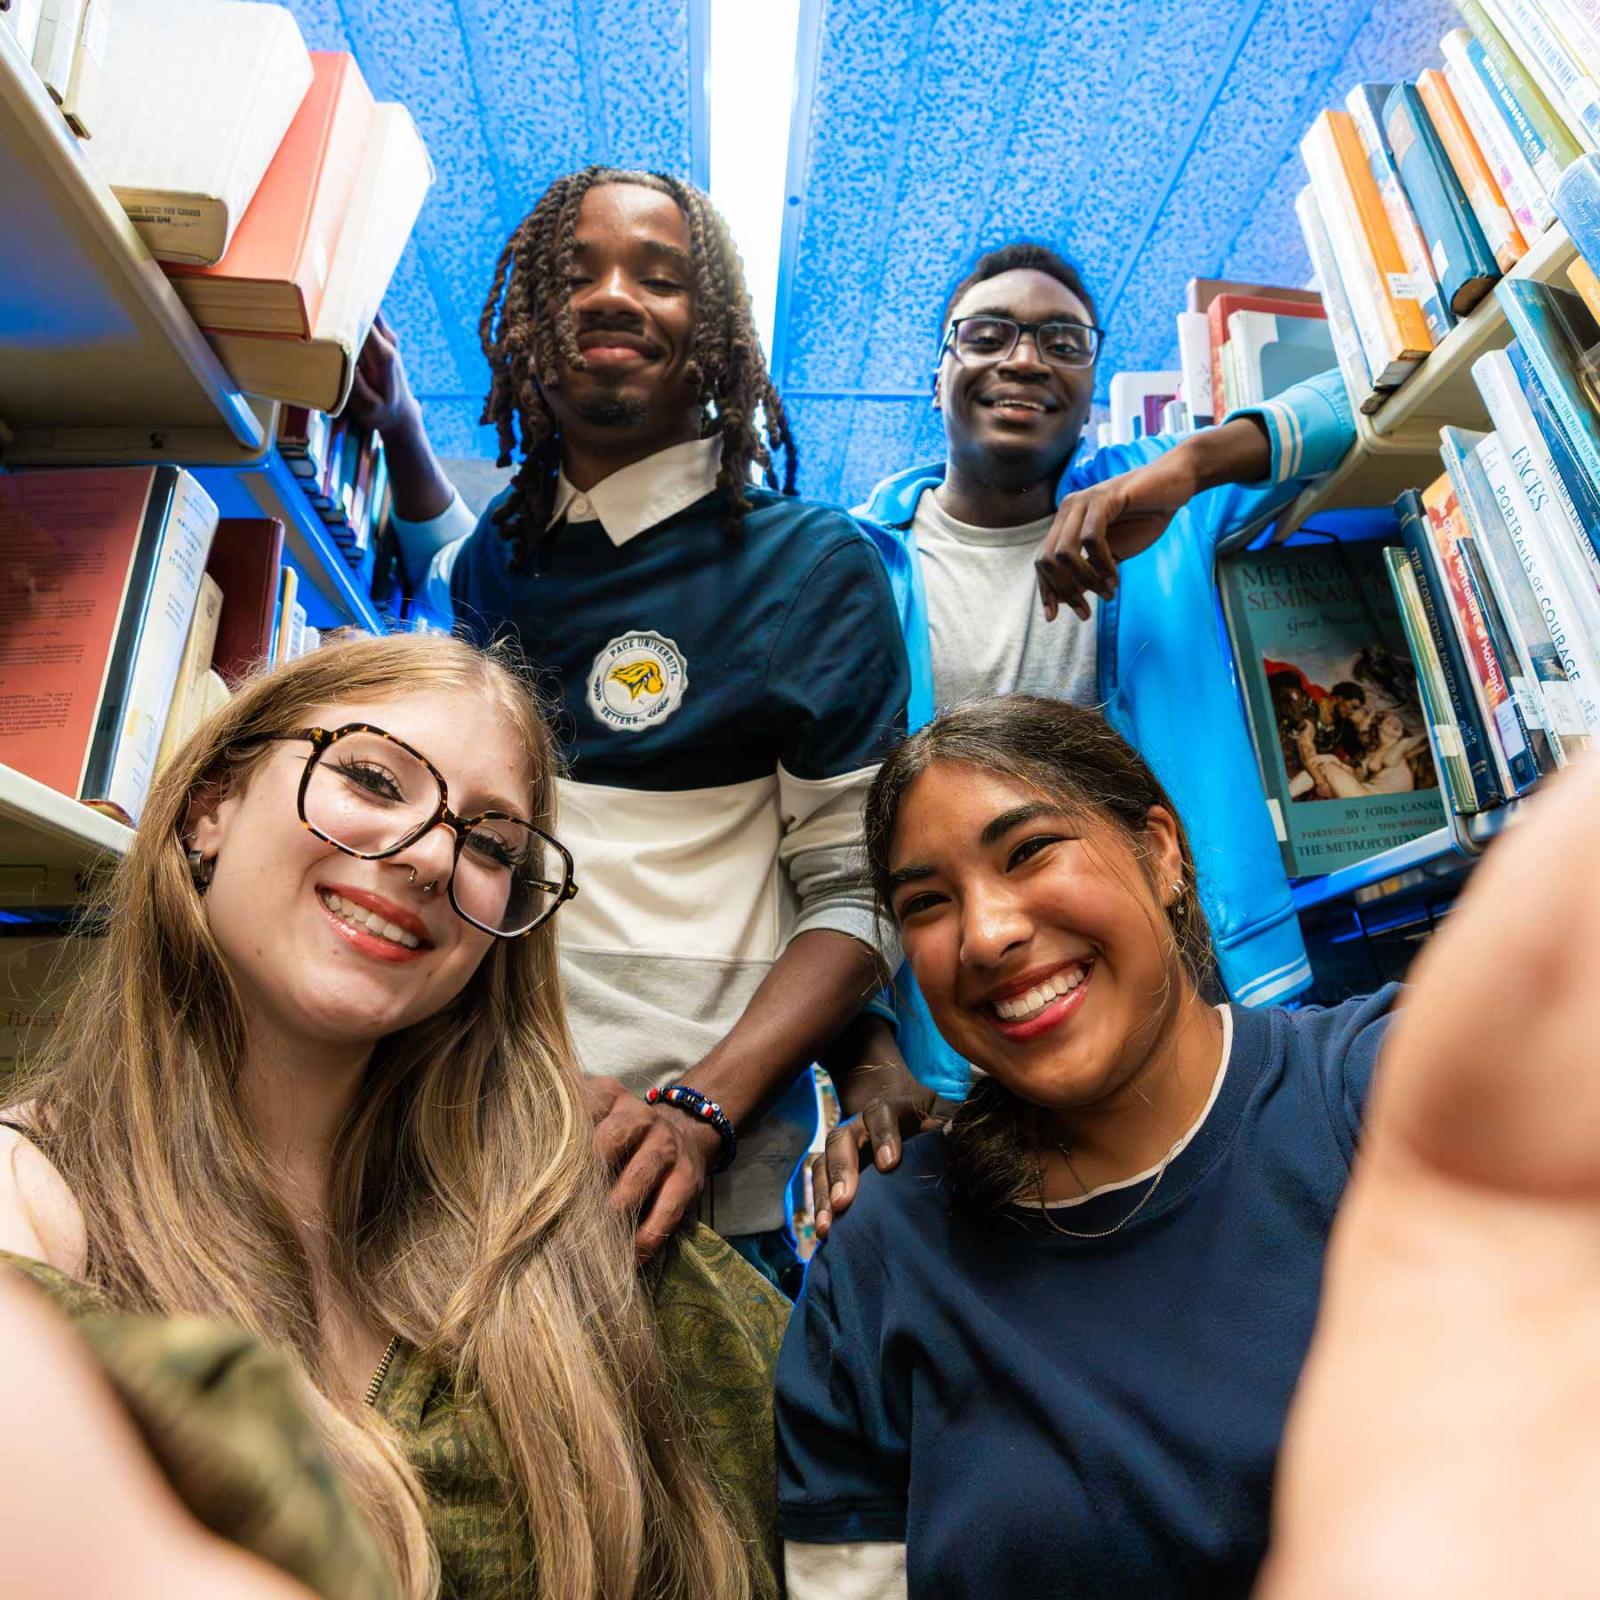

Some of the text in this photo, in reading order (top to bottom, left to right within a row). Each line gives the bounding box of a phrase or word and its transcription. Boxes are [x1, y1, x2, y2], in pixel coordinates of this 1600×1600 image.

[1512, 446, 1549, 512] FACES
[1248, 584, 1354, 611] SEMINAR
[1496, 485, 1538, 574] PORTRAITS
[1532, 576, 1544, 593] OF
[1540, 597, 1580, 681] COURAGE
[1442, 517, 1459, 556] Group
[1456, 556, 1479, 624] Portraiture
[1476, 627, 1485, 640] of
[1481, 641, 1502, 693] Holland
[1411, 547, 1463, 714] THE FLORENTINE PORTRAIT
[609, 638, 679, 675] PACE UNIVERSITY
[600, 706, 638, 725] SETTERS
[1345, 800, 1443, 819] BY JOHN CANAD
[1298, 845, 1324, 857] THE
